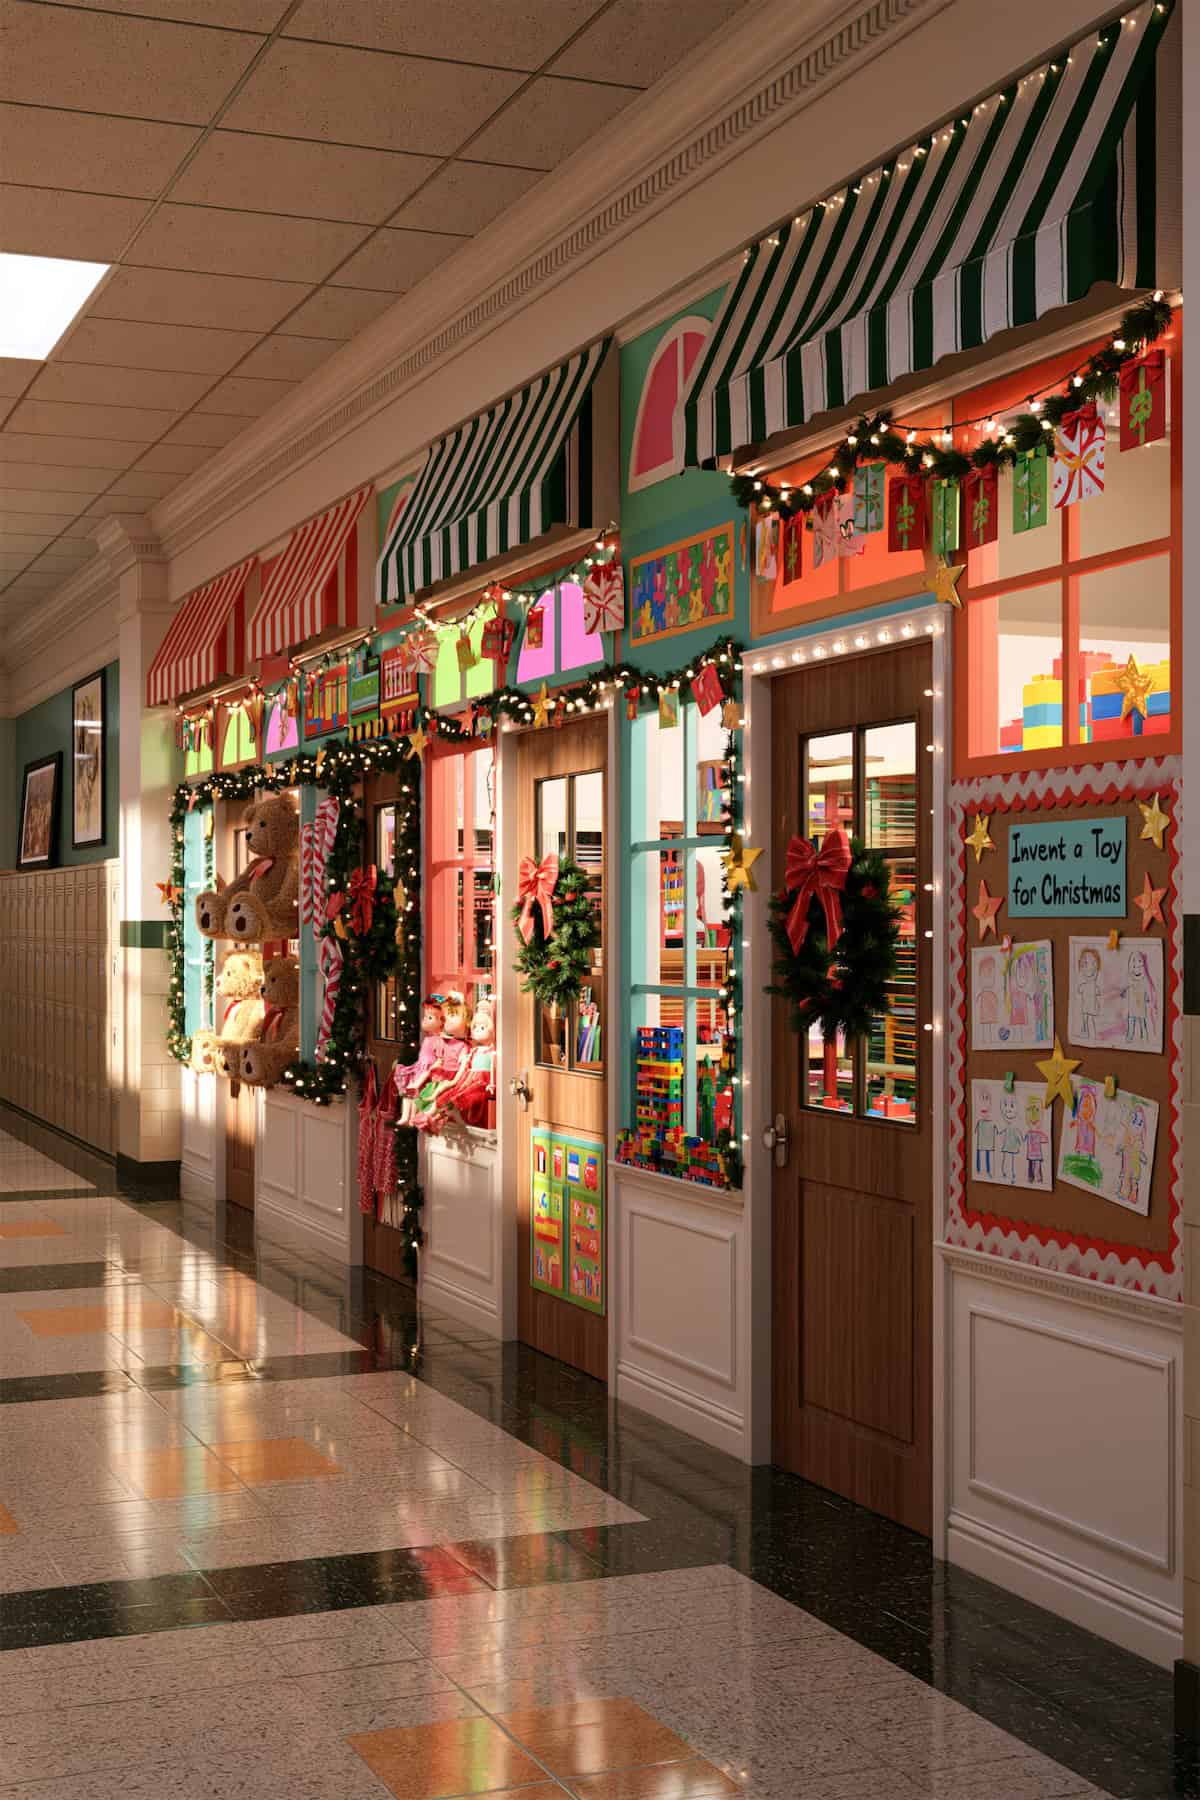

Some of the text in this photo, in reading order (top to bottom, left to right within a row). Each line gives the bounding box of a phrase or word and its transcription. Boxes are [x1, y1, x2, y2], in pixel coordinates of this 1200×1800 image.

[1012, 828, 1122, 864] Invent a Toy
[1012, 873, 1121, 906] for Christmas
